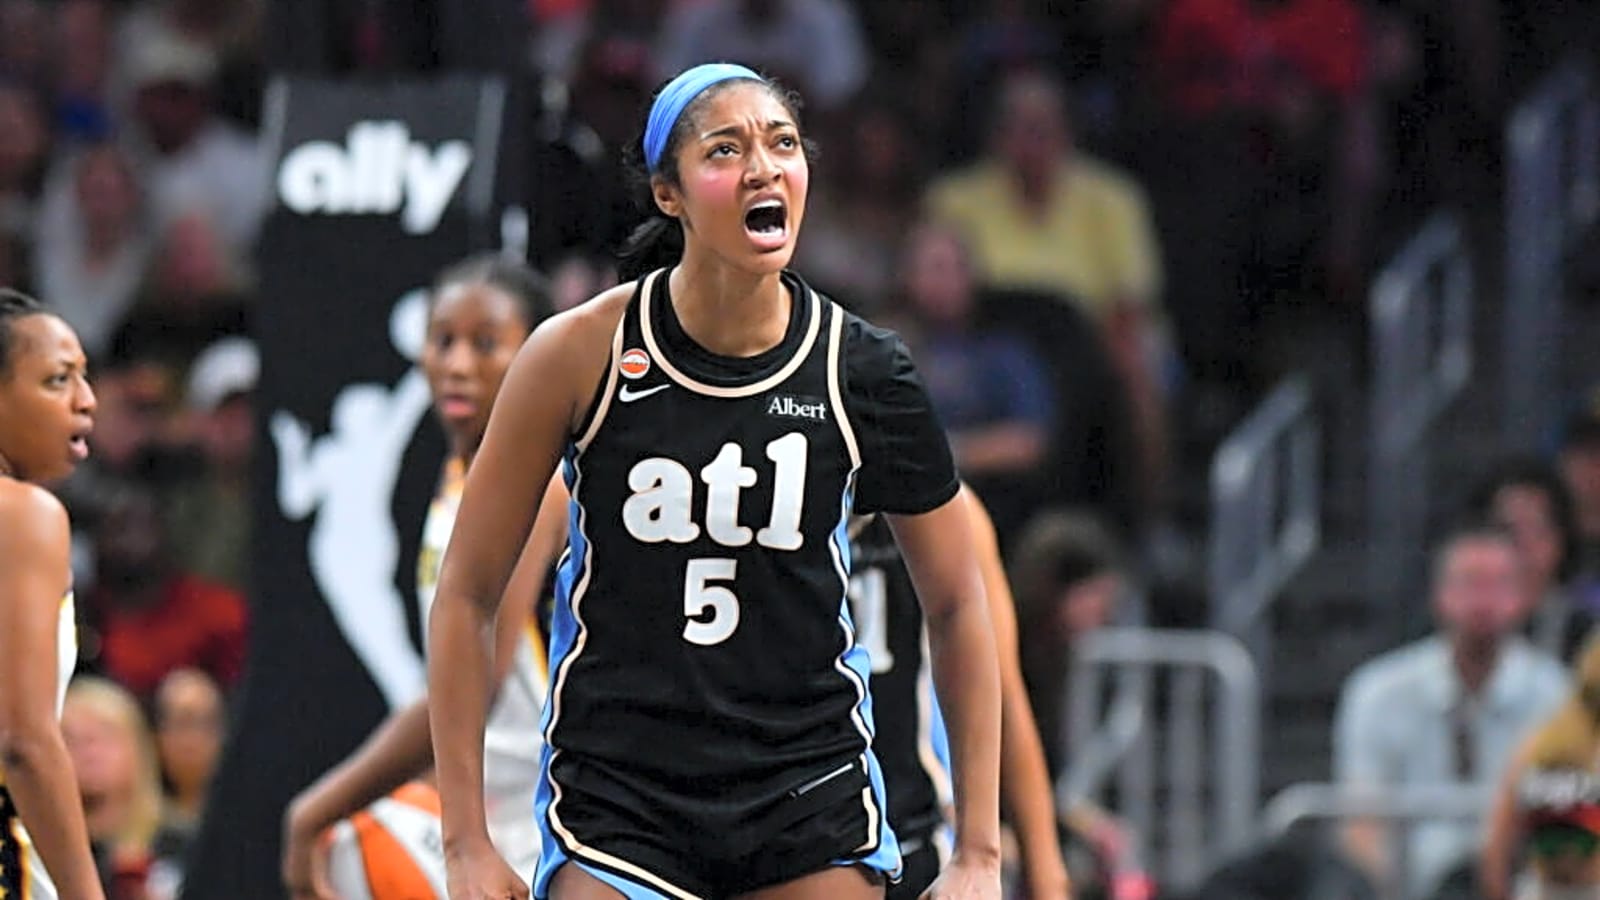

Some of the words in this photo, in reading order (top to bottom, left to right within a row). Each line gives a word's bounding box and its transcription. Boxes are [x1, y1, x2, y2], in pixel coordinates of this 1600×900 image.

[279, 120, 472, 235] ally
[768, 396, 826, 420] Albert
[682, 557, 741, 646] 5
